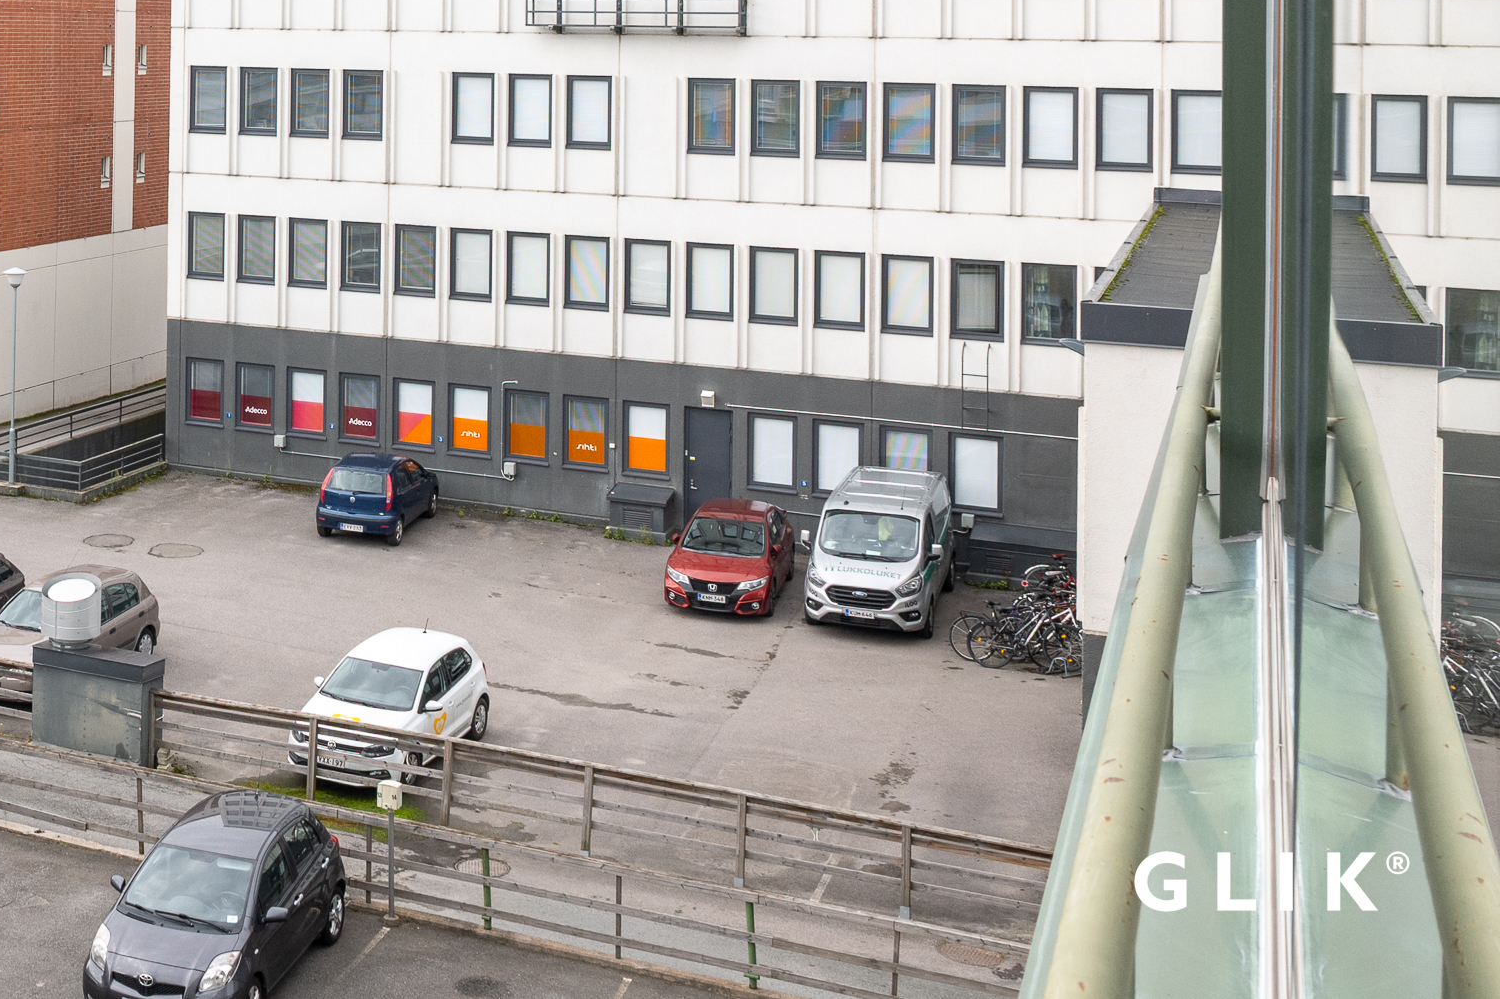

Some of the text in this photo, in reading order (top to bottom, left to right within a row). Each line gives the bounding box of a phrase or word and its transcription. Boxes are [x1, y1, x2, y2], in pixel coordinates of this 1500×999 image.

[244, 406, 268, 415] Adecco
[348, 417, 372, 427] Adecco
[837, 566, 902, 580] LUKKOLUKET
